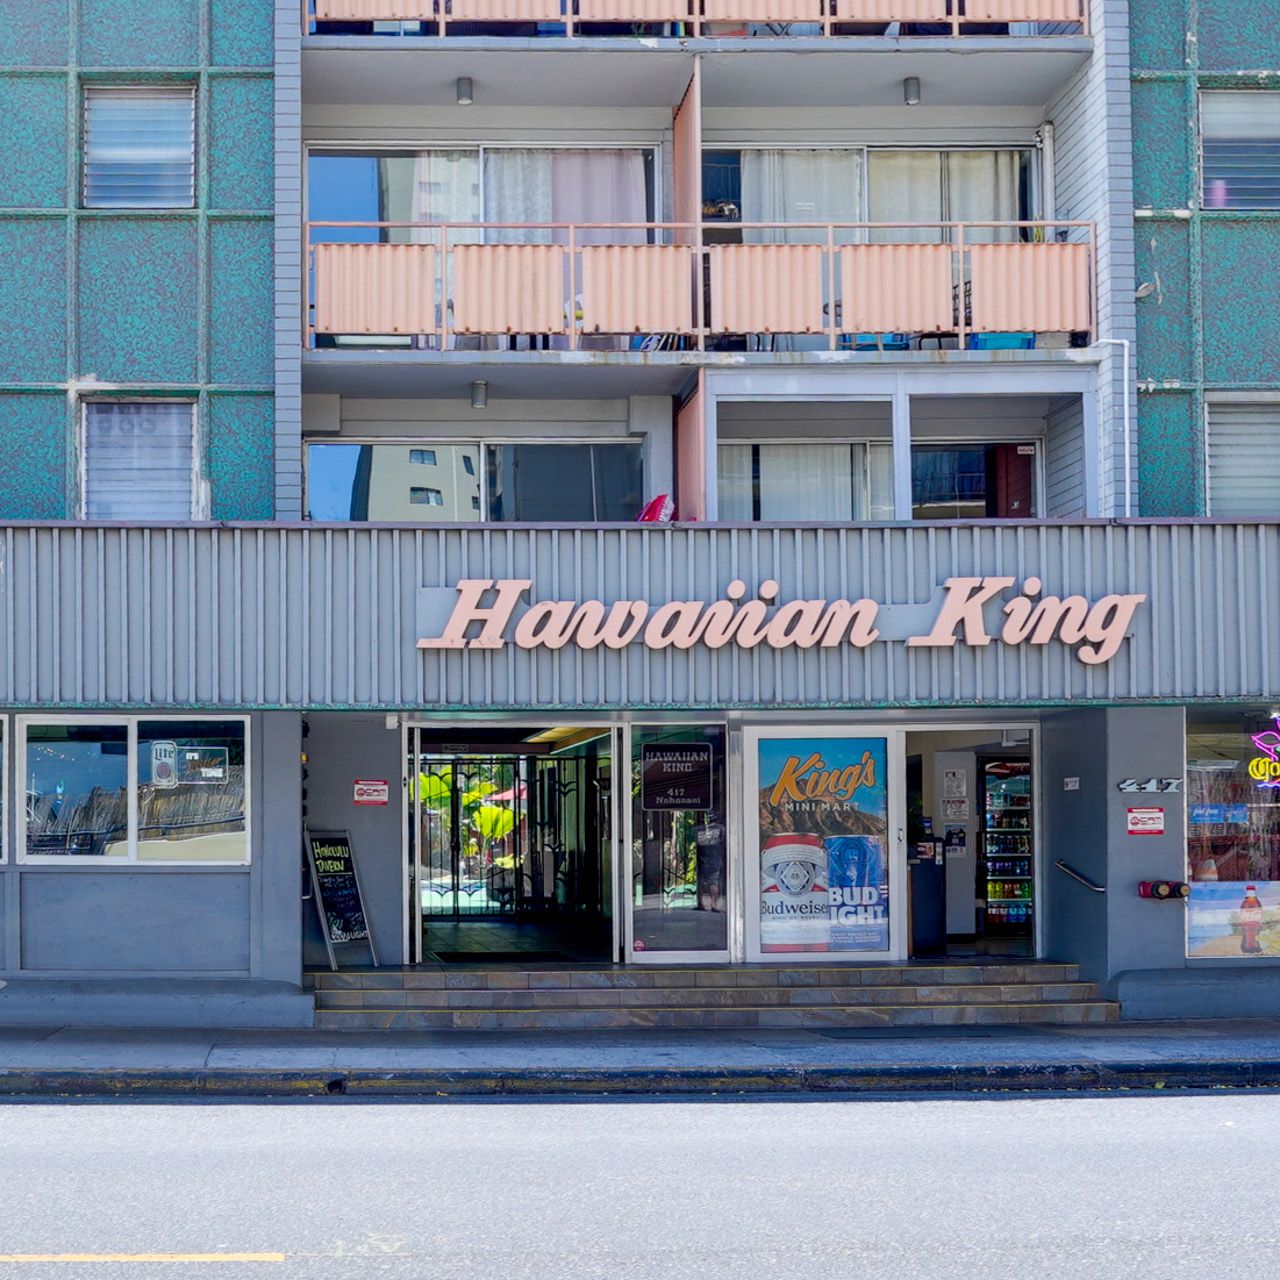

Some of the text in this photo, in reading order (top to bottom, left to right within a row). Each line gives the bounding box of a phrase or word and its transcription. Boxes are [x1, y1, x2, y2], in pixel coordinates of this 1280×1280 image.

[416, 576, 1147, 665] Hawaiian King
[155, 748, 174, 760] Lite
[646, 752, 708, 761] HAWAIIAN
[663, 763, 693, 772] KING
[770, 751, 875, 806] King's
[1118, 778, 1183, 792] 417
[666, 788, 685, 796] 417
[785, 802, 860, 812] MINI MART
[829, 886, 879, 905] BUD
[761, 900, 829, 915] Budweise
